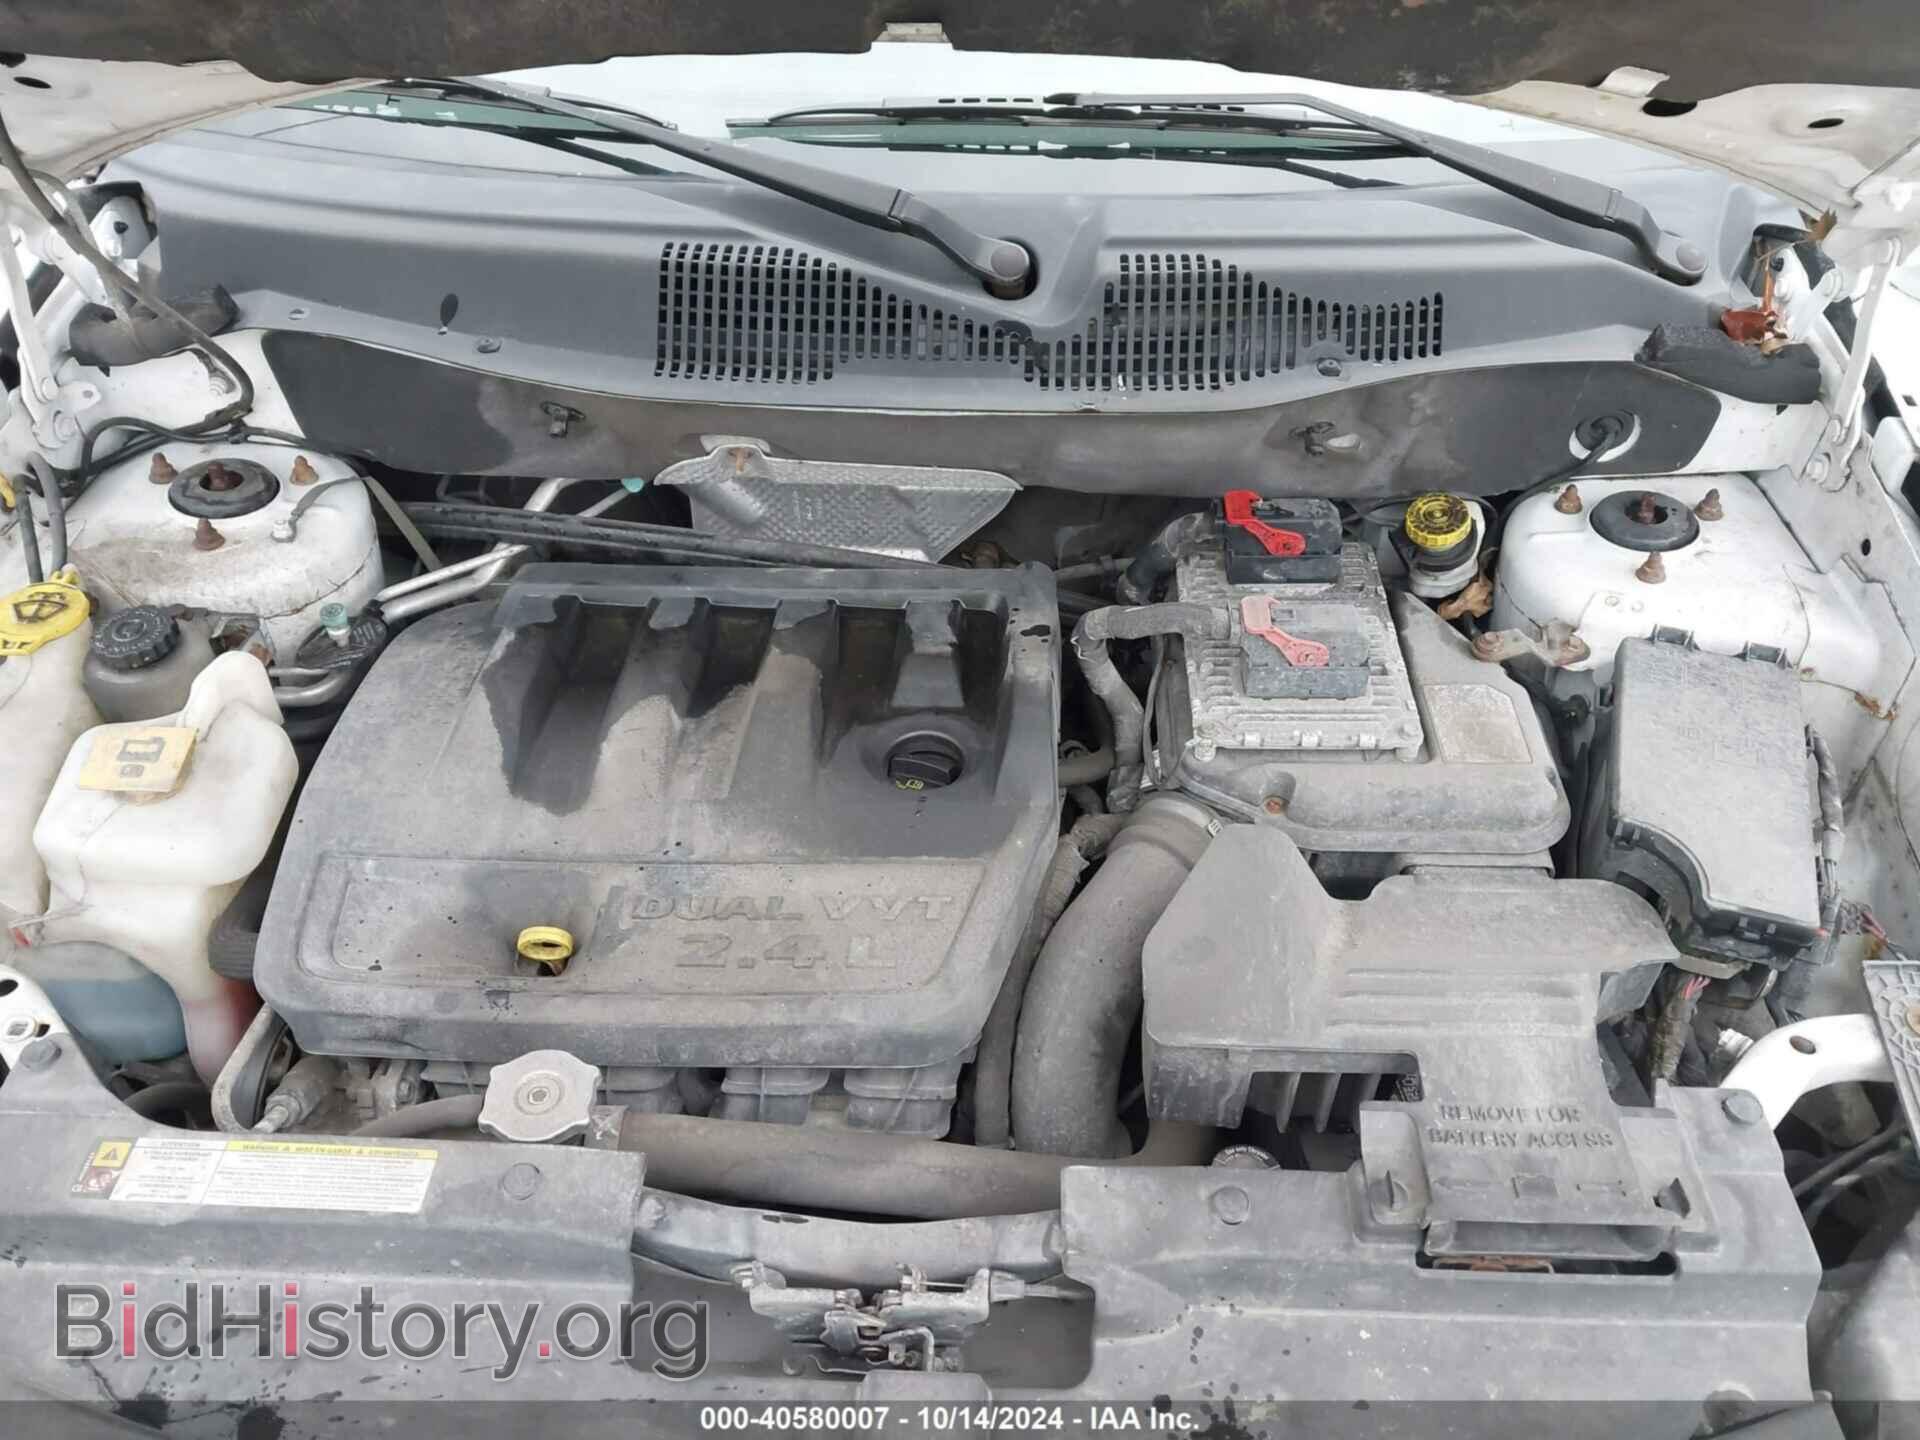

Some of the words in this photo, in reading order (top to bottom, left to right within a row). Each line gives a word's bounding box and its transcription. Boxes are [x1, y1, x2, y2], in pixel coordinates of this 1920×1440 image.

[632, 896, 803, 921] DUAL
[819, 896, 953, 921] VVT
[1440, 1104, 1528, 1123] REMOVE
[1536, 1105, 1581, 1123] FOR
[1428, 1127, 1518, 1147] BATTERY
[1527, 1131, 1614, 1148] ACCESS
